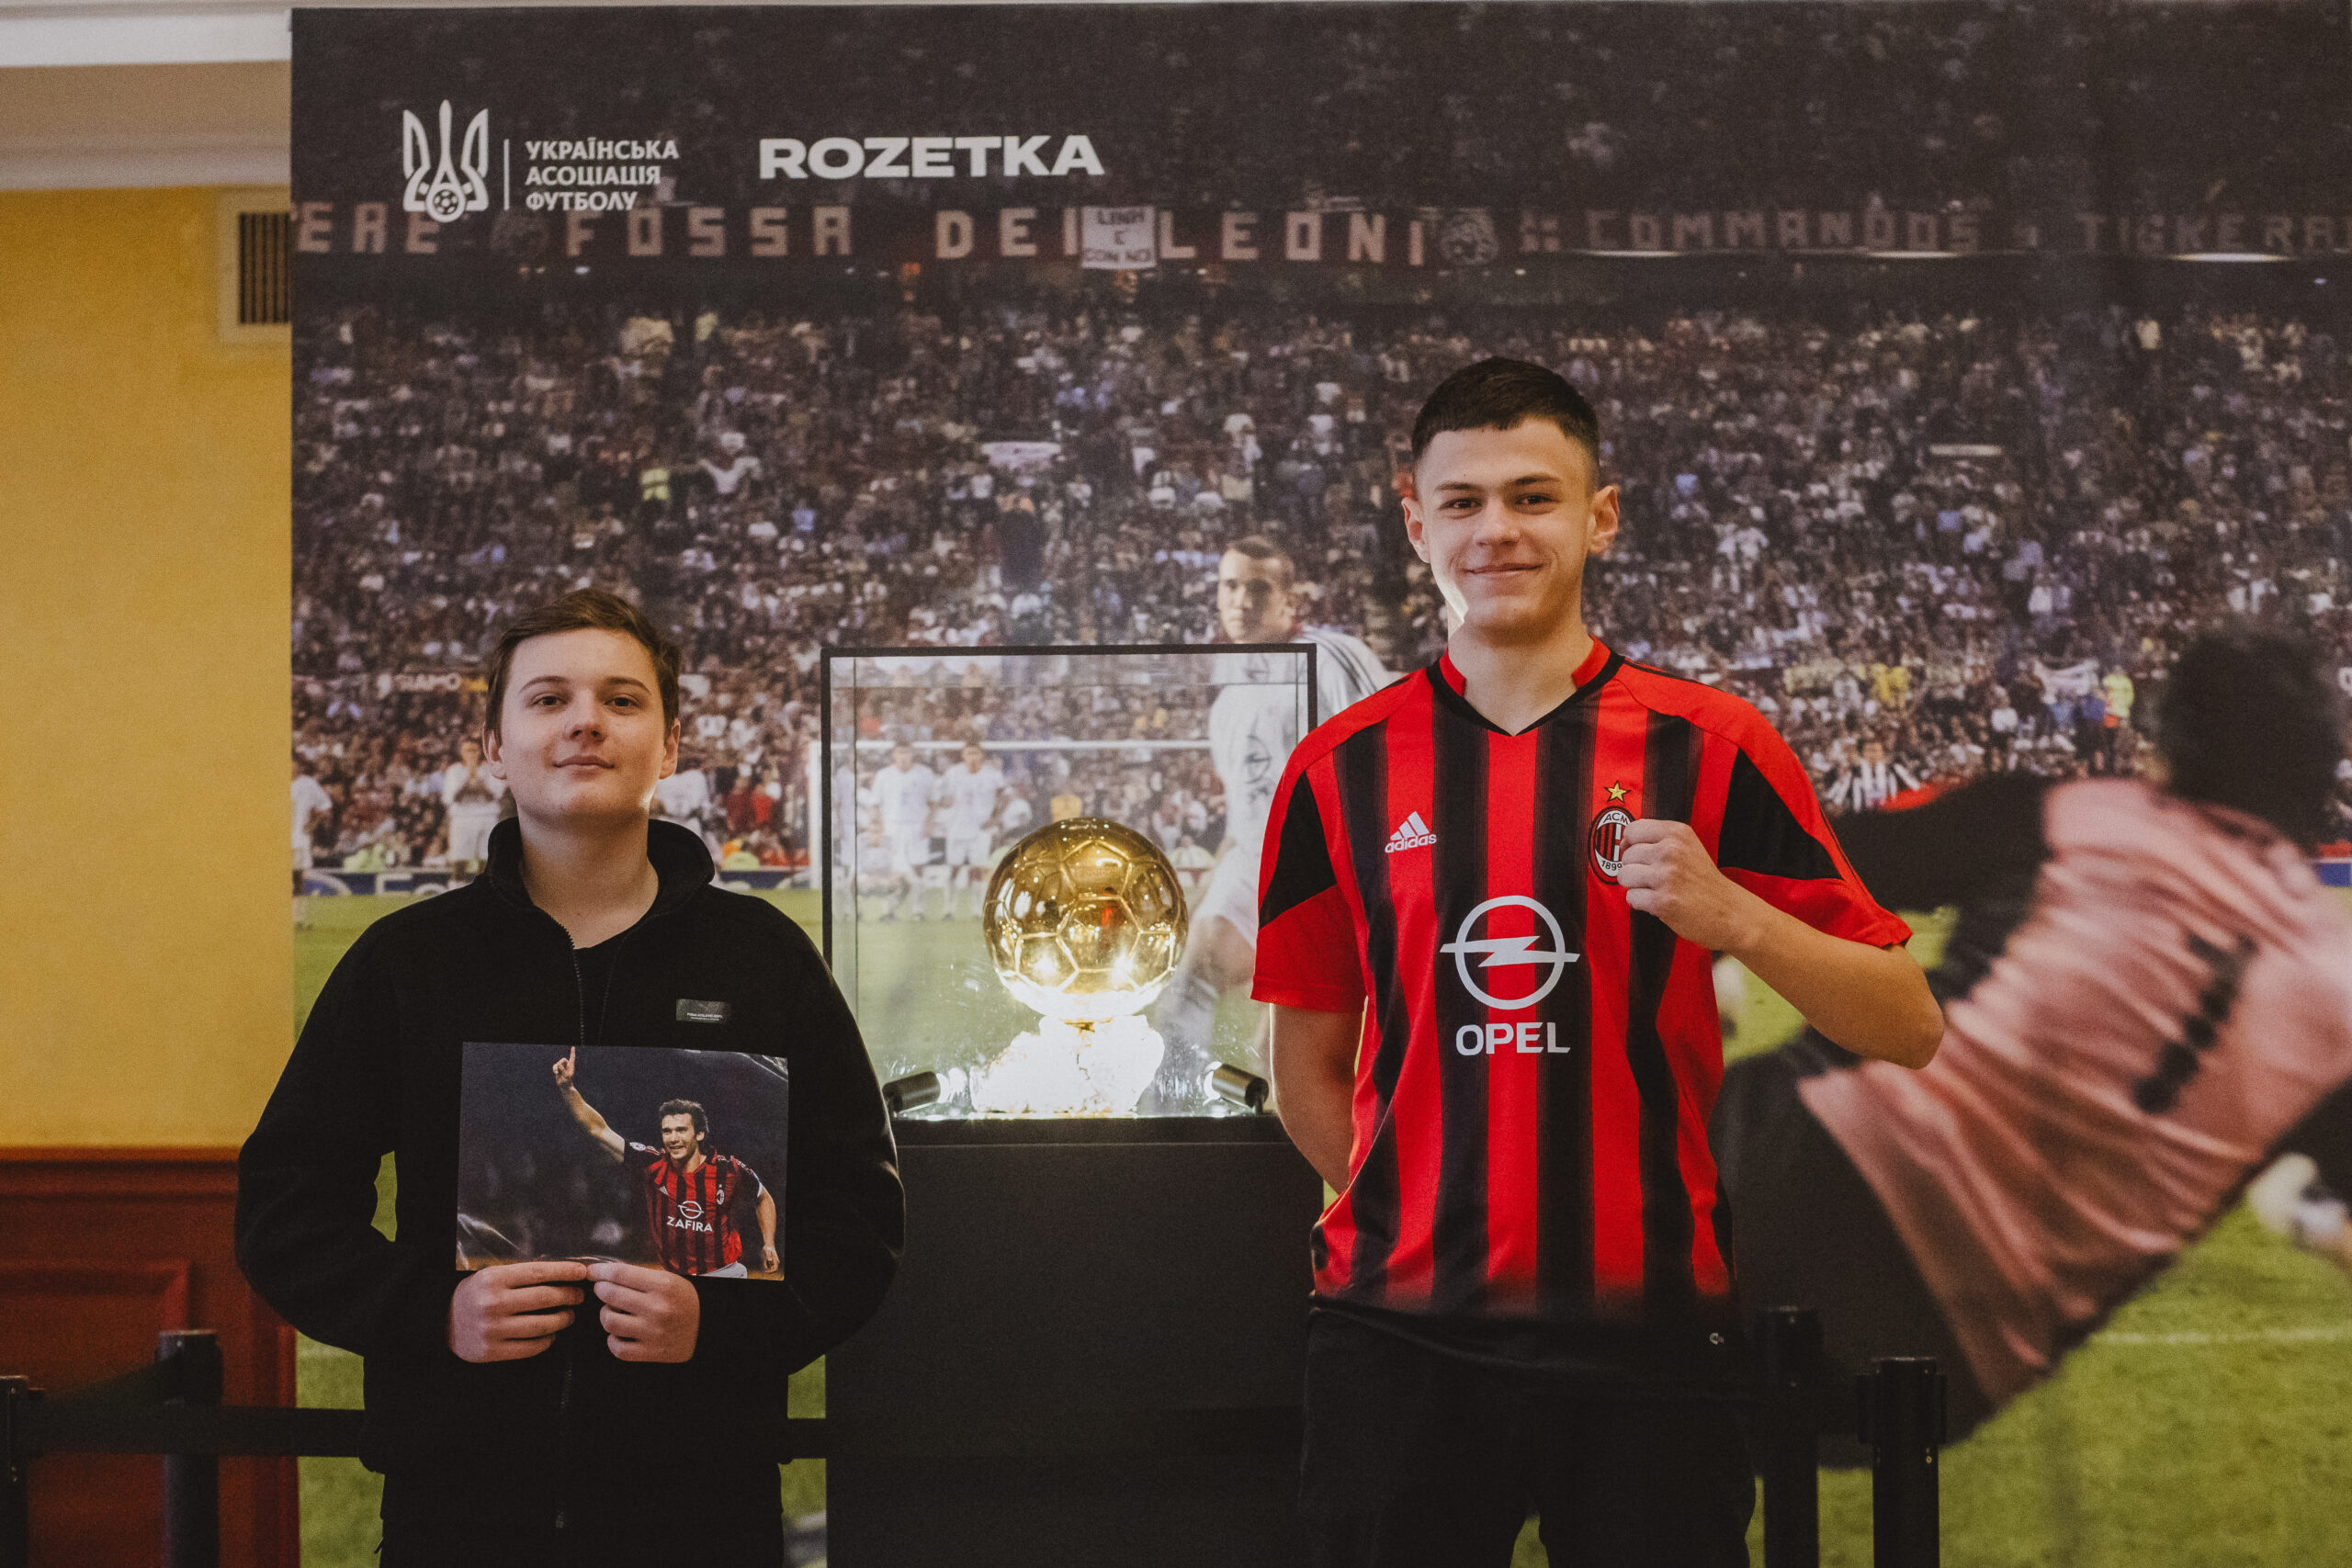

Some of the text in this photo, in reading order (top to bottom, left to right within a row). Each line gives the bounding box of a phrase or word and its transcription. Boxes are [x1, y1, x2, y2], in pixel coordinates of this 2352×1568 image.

[525, 137, 680, 160] УКРАЇНСЬКА
[760, 135, 1104, 179] ROZETKA
[525, 165, 662, 186] АСОЦІАЦІЯ
[526, 191, 639, 212] ФУТБОЛУ
[566, 206, 852, 257] FOSSA
[1159, 209, 1426, 266] LEONI
[1602, 812, 1629, 826] ACM
[1385, 834, 1437, 853] adidas
[1455, 1021, 1571, 1056] OPEL
[666, 1215, 713, 1232] ZAFIRA
